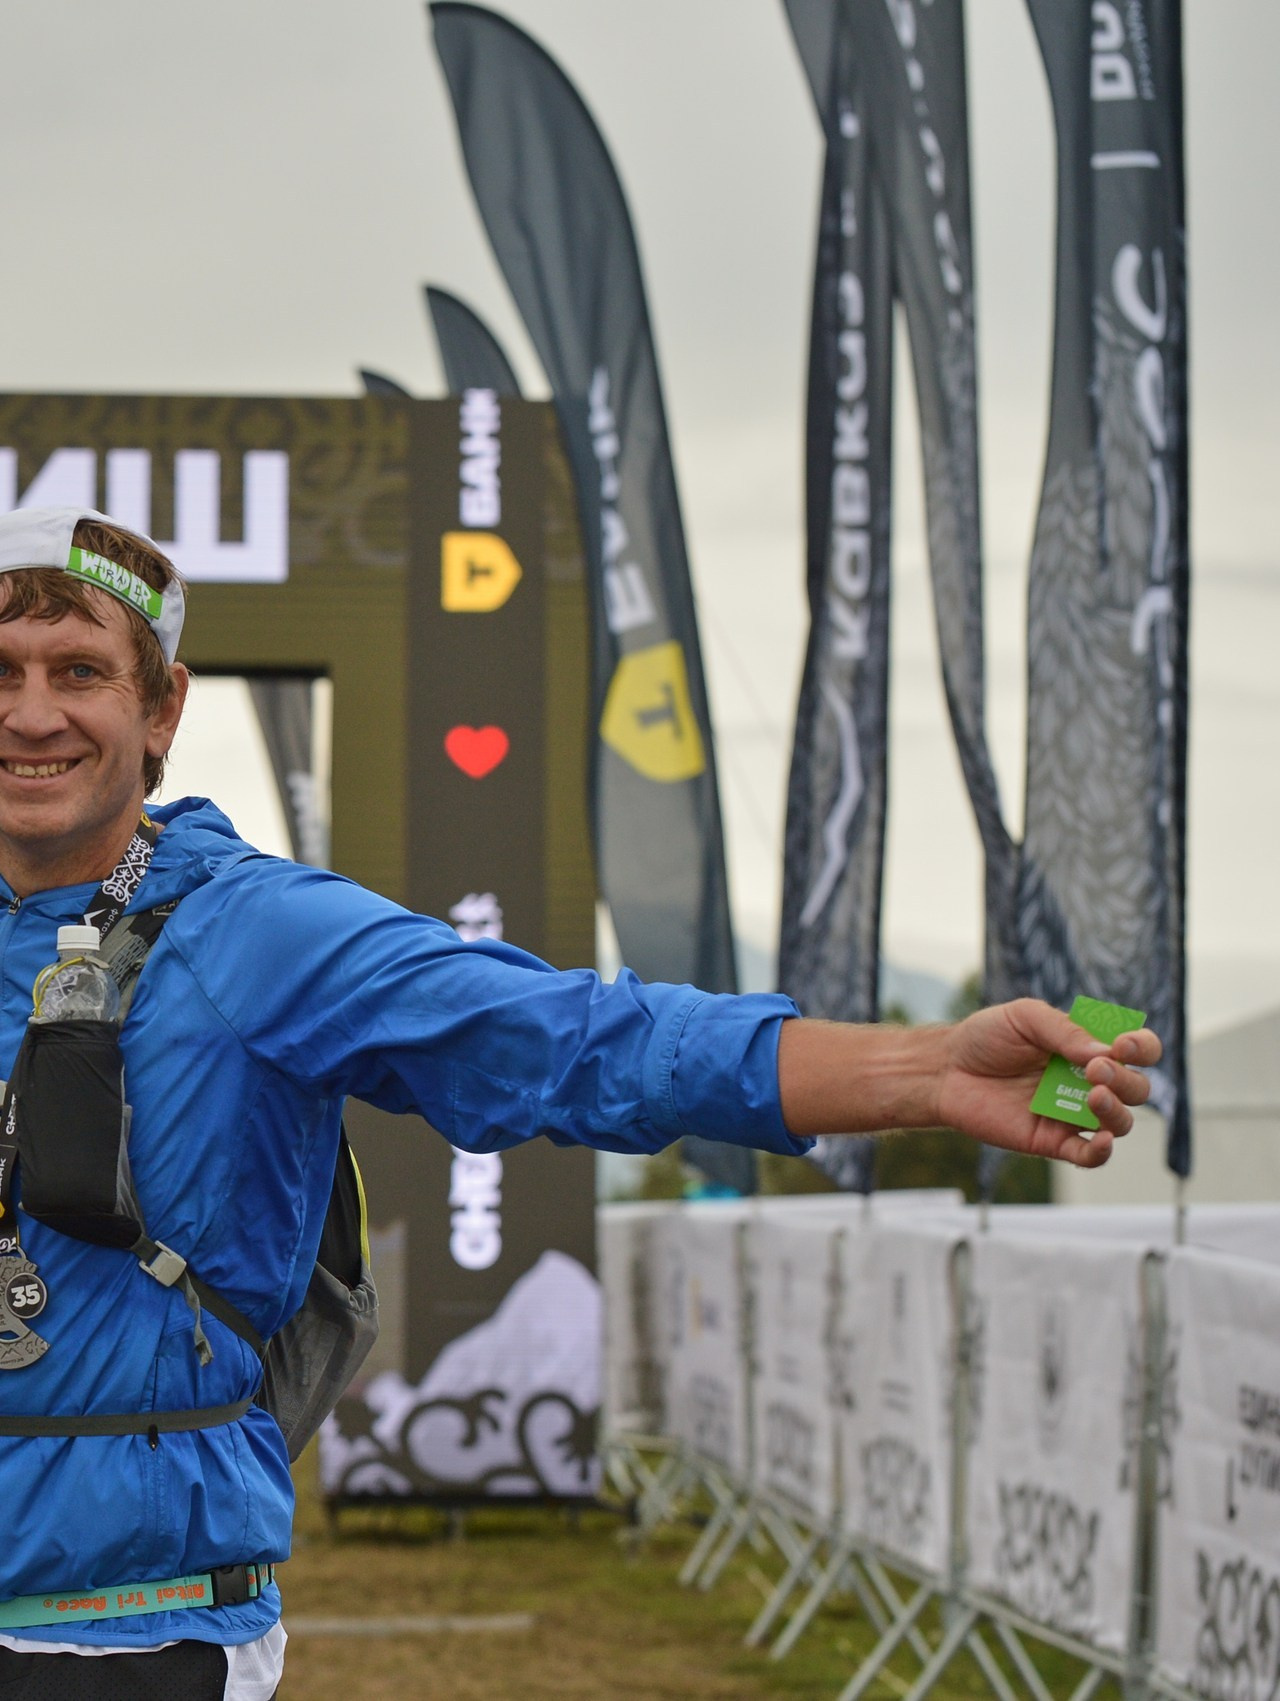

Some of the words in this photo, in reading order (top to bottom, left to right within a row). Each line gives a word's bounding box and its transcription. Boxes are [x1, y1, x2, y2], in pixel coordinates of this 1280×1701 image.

[11, 1283, 41, 1308] 35
[117, 1590, 147, 1609] Tri
[158, 1580, 205, 1605] Altai
